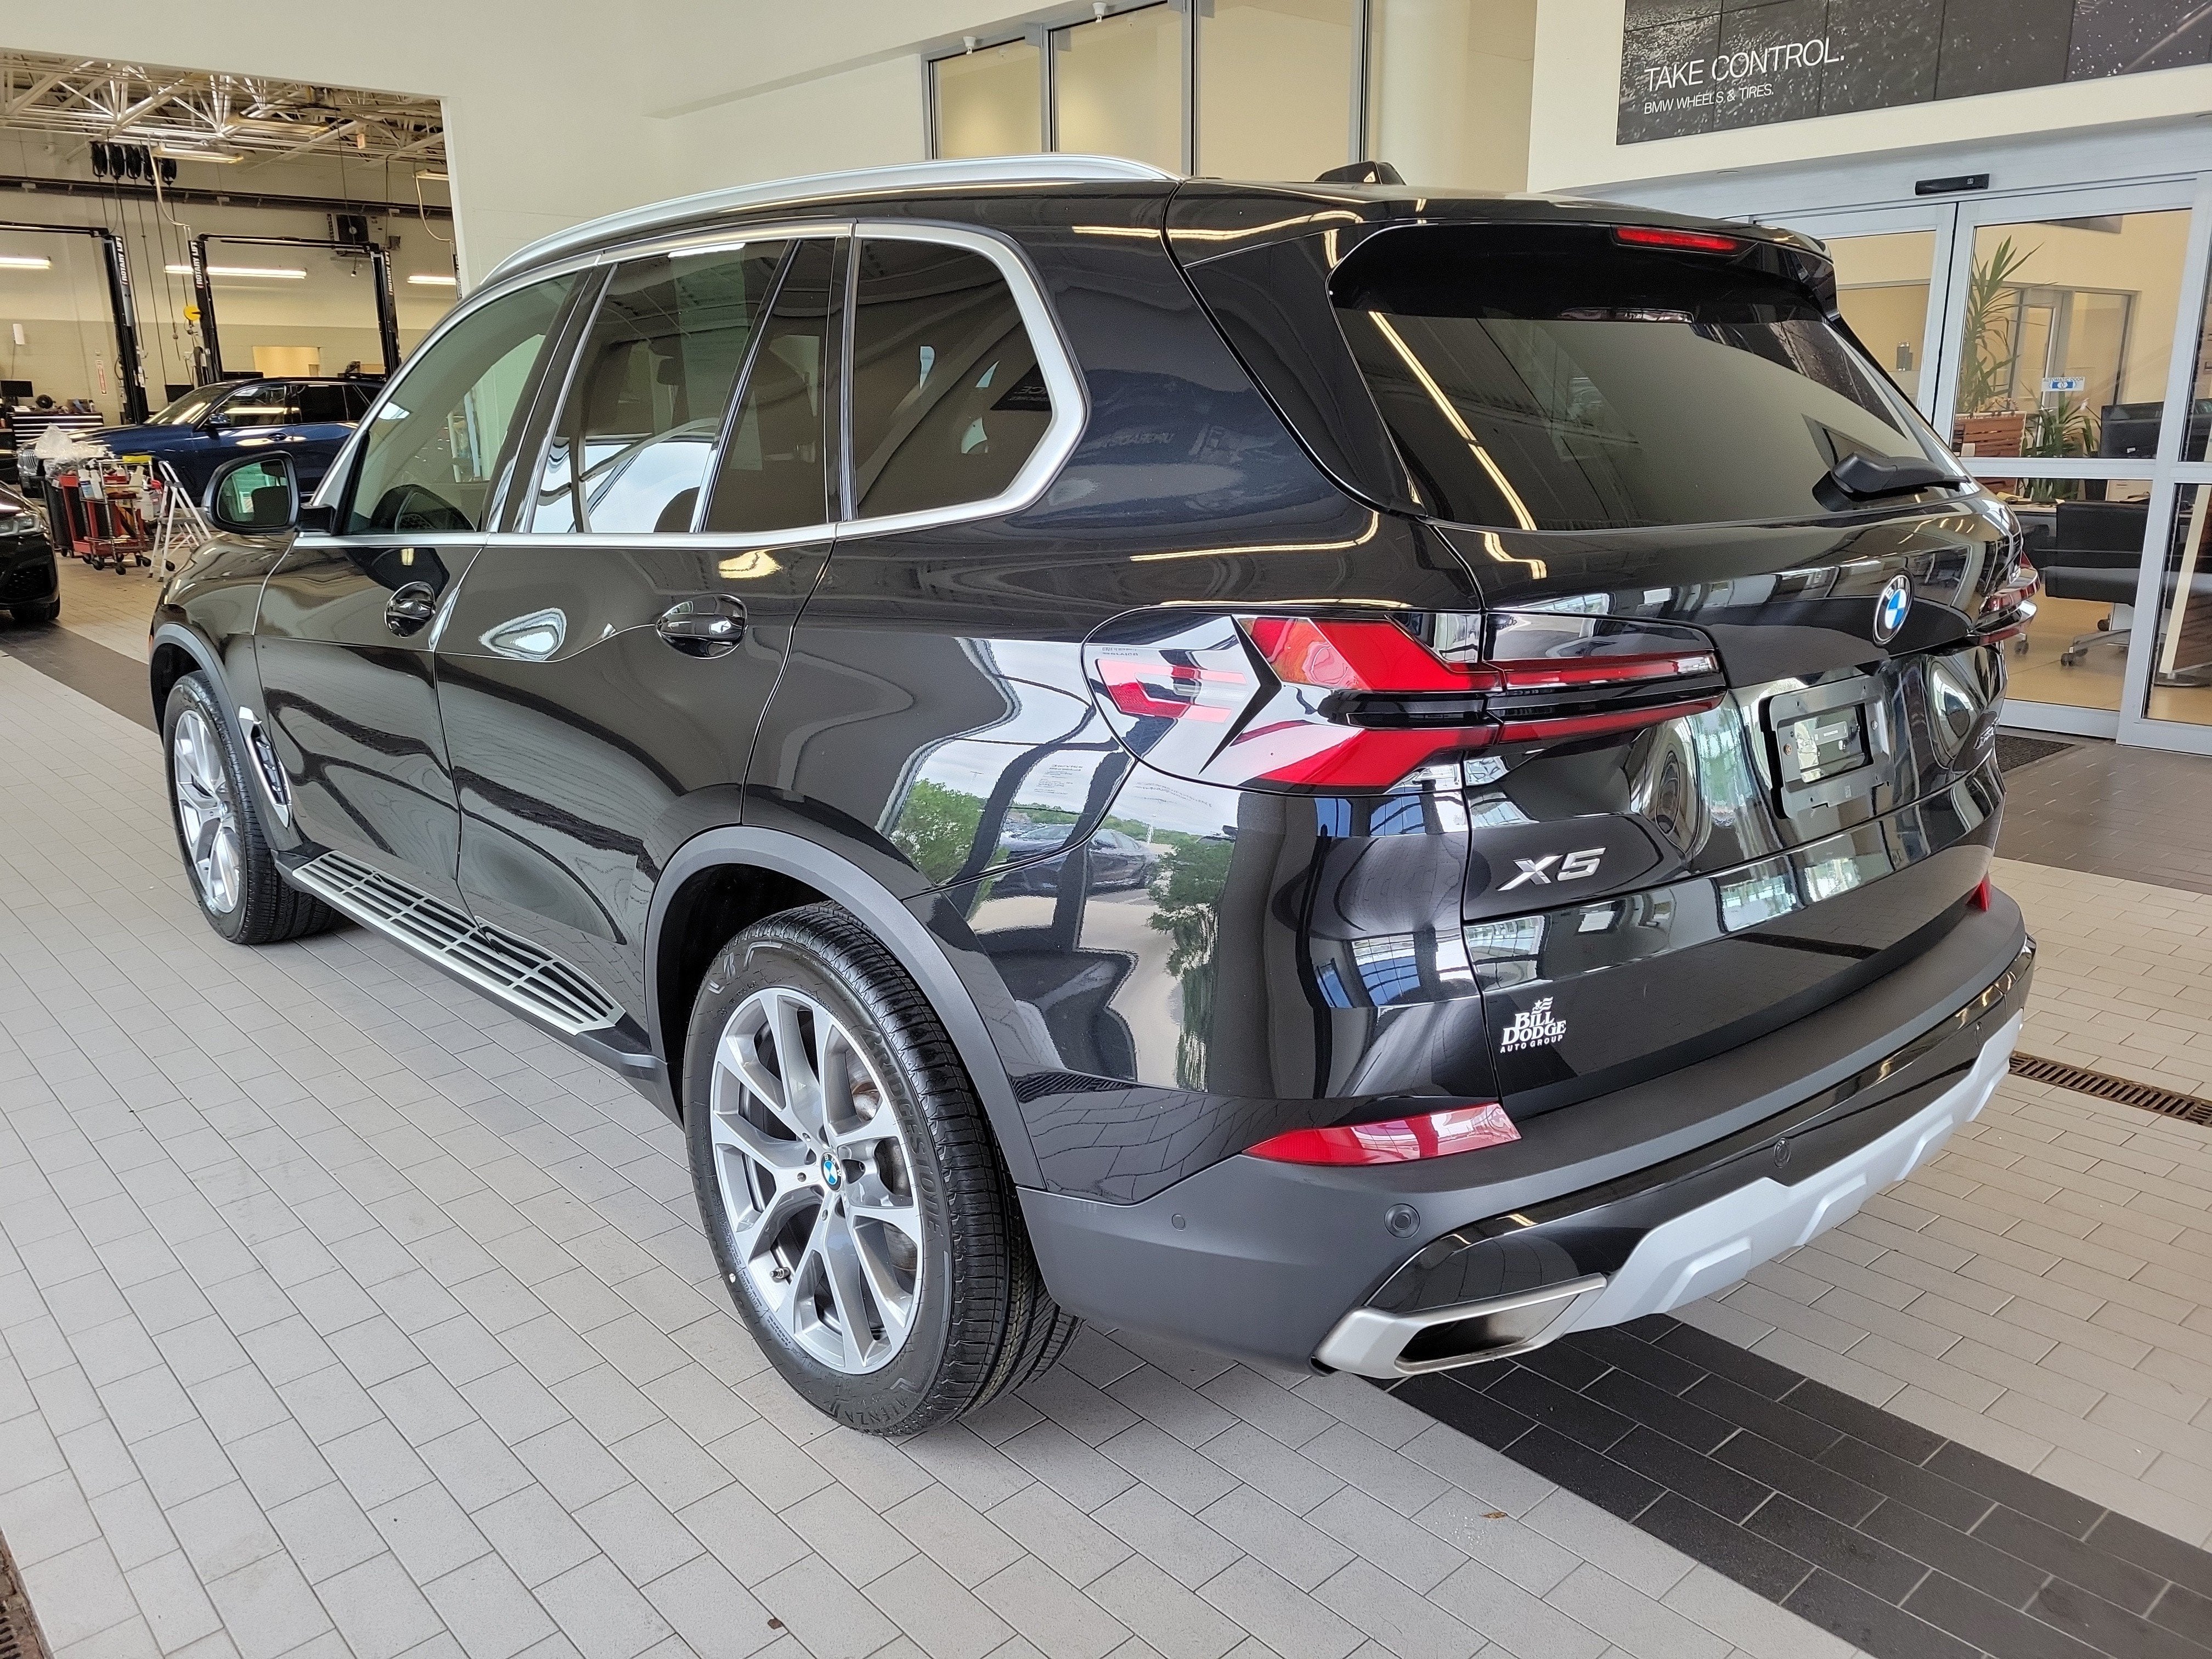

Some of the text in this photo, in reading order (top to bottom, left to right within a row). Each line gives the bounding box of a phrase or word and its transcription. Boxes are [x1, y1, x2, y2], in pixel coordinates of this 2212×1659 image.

[1644, 37, 1845, 92] TAKE CONTROL.
[1644, 83, 1774, 115] BMW WHEELS & TIRES.
[115, 236, 128, 281] ROTARY LIFT
[190, 241, 204, 284] ROTARY LIFT
[1496, 848, 1606, 891] X5
[1501, 1020, 1567, 1045] DODGE
[1515, 1011, 1555, 1030] BILL
[1500, 1035, 1563, 1053] AUTO GROUP
[824, 1154, 842, 1177] BMW
